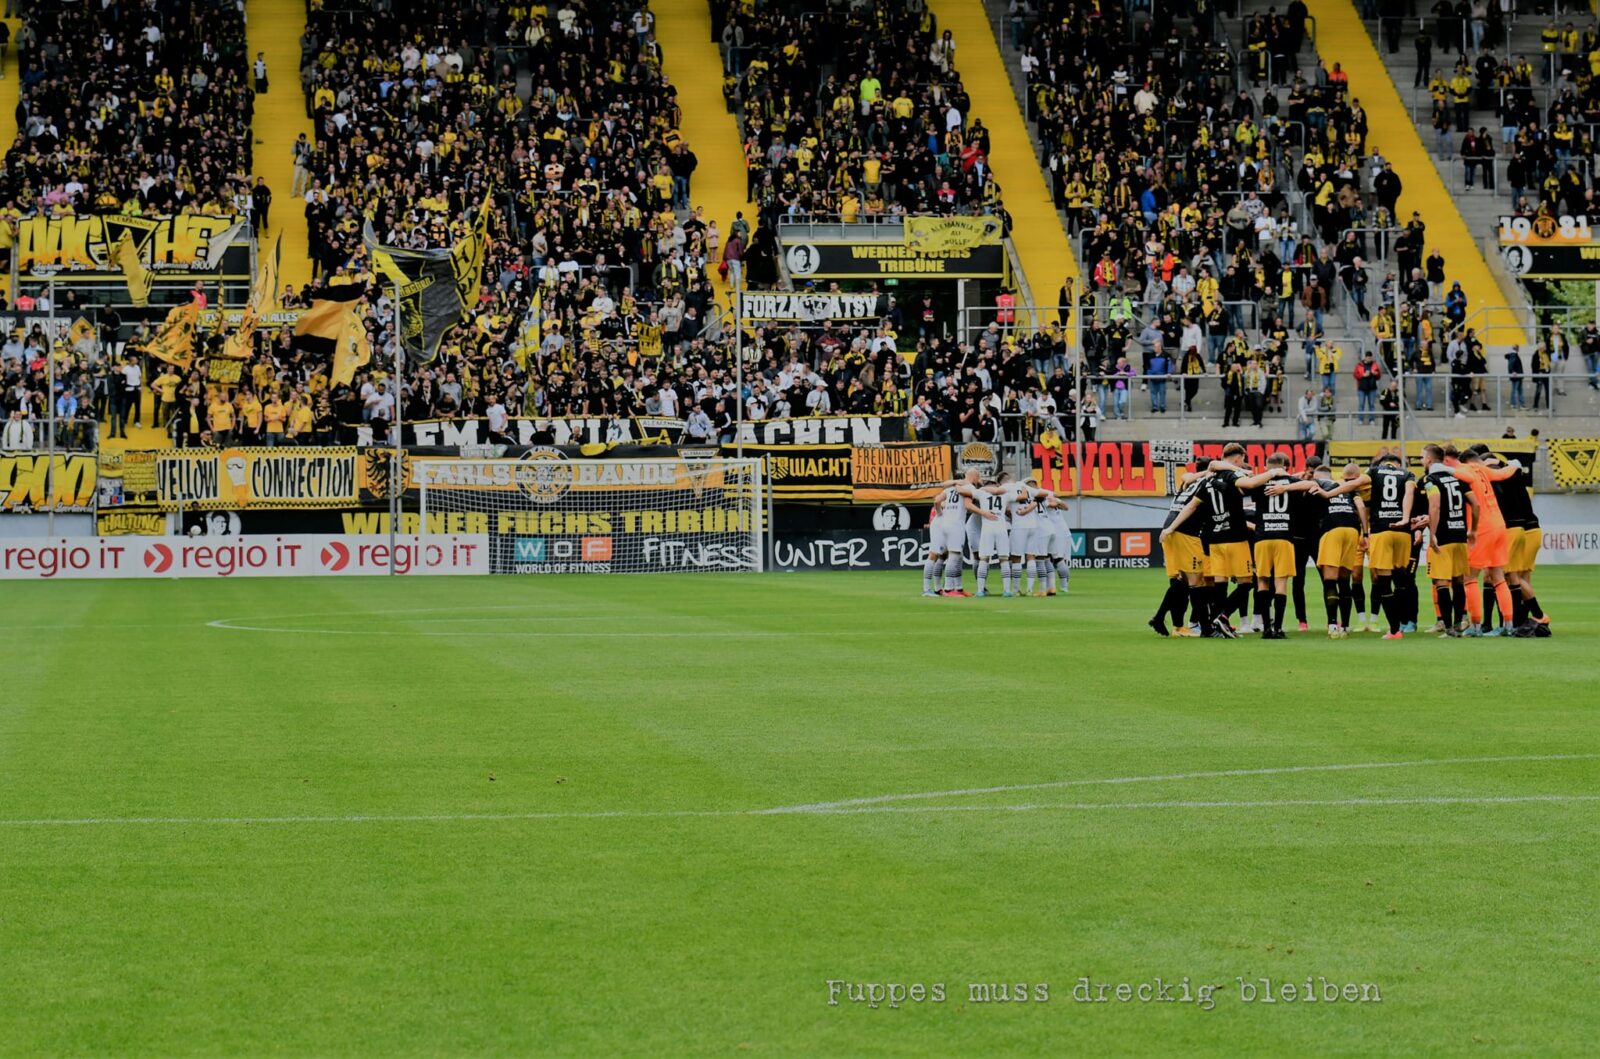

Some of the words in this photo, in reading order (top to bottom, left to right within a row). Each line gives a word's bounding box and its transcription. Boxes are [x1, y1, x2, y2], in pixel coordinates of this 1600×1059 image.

[931, 220, 974, 233] ALEMANNIA
[1500, 216, 1531, 241] 19
[1559, 215, 1590, 239] 81
[851, 246, 917, 259] WERNER
[878, 258, 945, 273] TRIBÜNE
[742, 295, 800, 319] FORZA
[829, 294, 878, 318] ATSV
[705, 417, 882, 445] ACHEN
[789, 458, 850, 477] WACHT
[857, 446, 943, 466] FREUNDSCHAFT
[157, 457, 219, 500] YELLOW
[251, 455, 354, 499] CONNECTION
[576, 461, 677, 486] BANDE
[856, 463, 945, 484] ZUSAMMENHALT
[948, 490, 960, 503] 18
[1207, 486, 1225, 515] 11
[1267, 485, 1289, 513] 10
[1382, 475, 1398, 501] 8
[1443, 481, 1463, 511] 15
[986, 496, 1002, 511] 14
[104, 513, 161, 533] HALTUNG
[341, 511, 488, 534] WERNER
[498, 510, 613, 534] FUCHS
[620, 505, 768, 534] TRIBÜNE
[5, 539, 91, 577] regio
[100, 538, 125, 569] iT
[182, 538, 267, 576] regio
[277, 537, 302, 567] iT
[359, 536, 443, 574] regio
[452, 537, 478, 566] iT
[643, 537, 761, 568] FITNESS
[775, 538, 871, 567] UNTER
[1066, 559, 1091, 569] ORLD
[1094, 558, 1107, 568] OF
[1108, 558, 1150, 569] FITNESS
[515, 564, 550, 575] WORLD
[554, 564, 567, 574] OF
[569, 562, 612, 574] FITNESS
